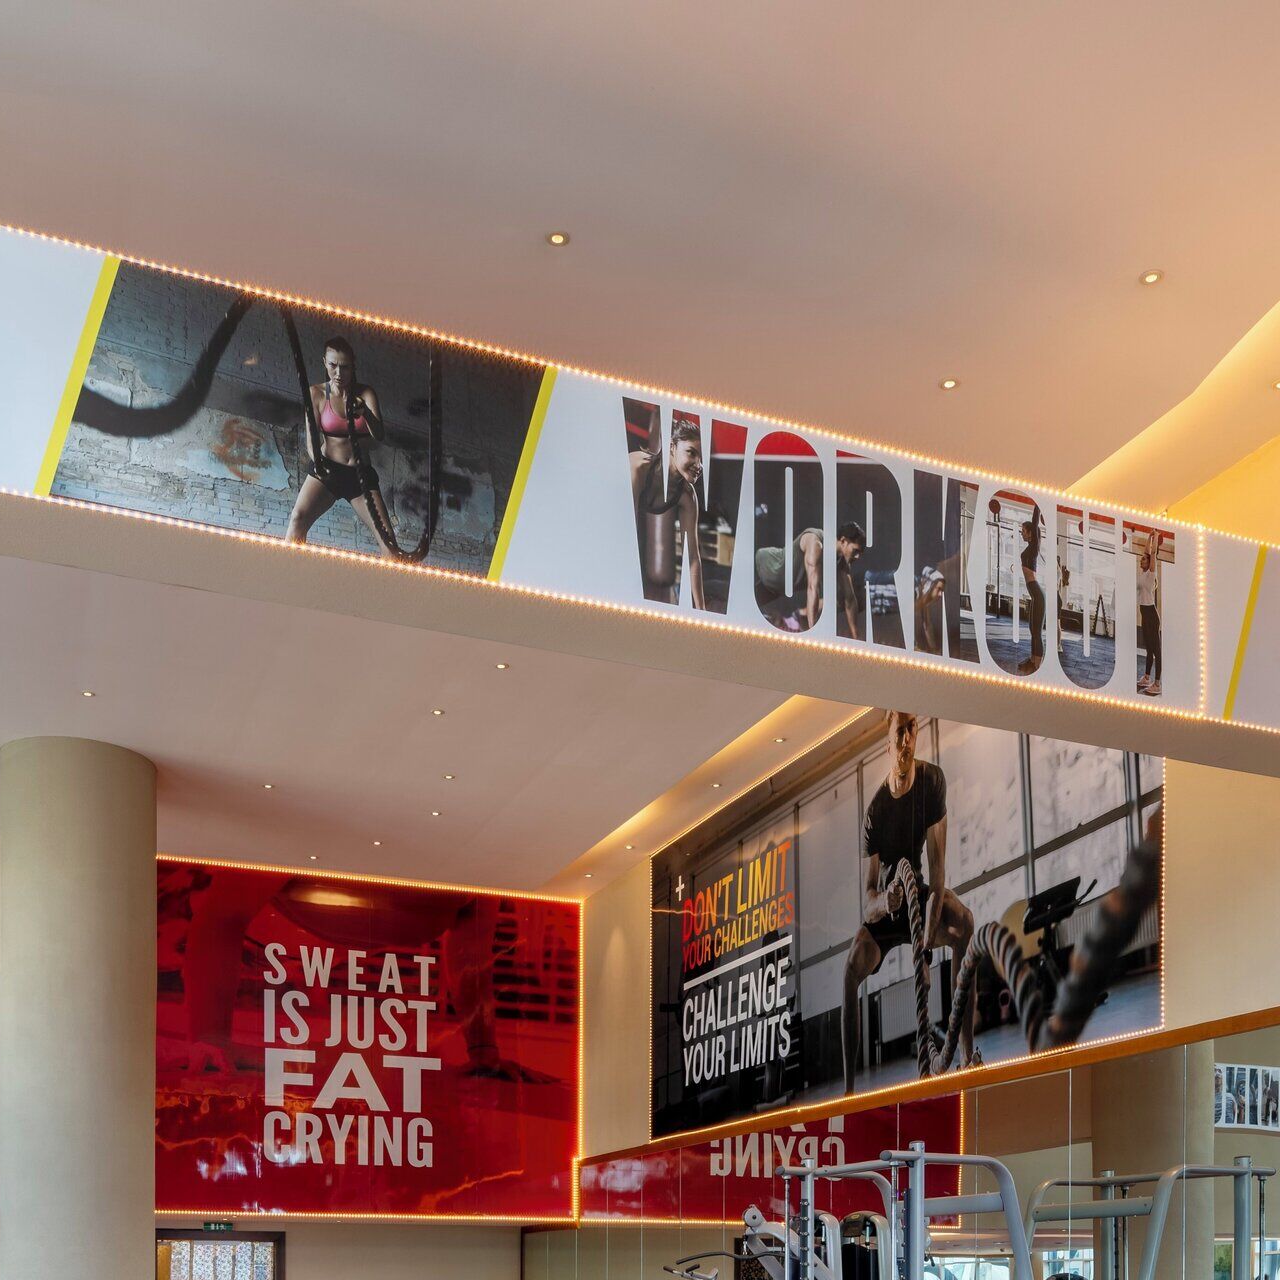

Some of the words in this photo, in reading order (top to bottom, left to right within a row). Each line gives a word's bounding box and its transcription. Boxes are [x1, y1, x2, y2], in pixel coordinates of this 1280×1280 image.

[622, 396, 1176, 696] WORKOUT
[682, 873, 734, 942] DON'T
[736, 840, 791, 914] LIMIT
[263, 942, 436, 996] SWEAT
[683, 933, 721, 974] YOUR
[714, 892, 794, 957] CHALLENGES
[263, 988, 311, 1045] IS
[325, 993, 436, 1053] JUST
[683, 957, 789, 1043] CHALLENGE
[264, 1048, 442, 1113] FAT
[683, 1034, 725, 1087] YOUR
[730, 1011, 791, 1073] LIMITS
[263, 1110, 434, 1168] CRYING
